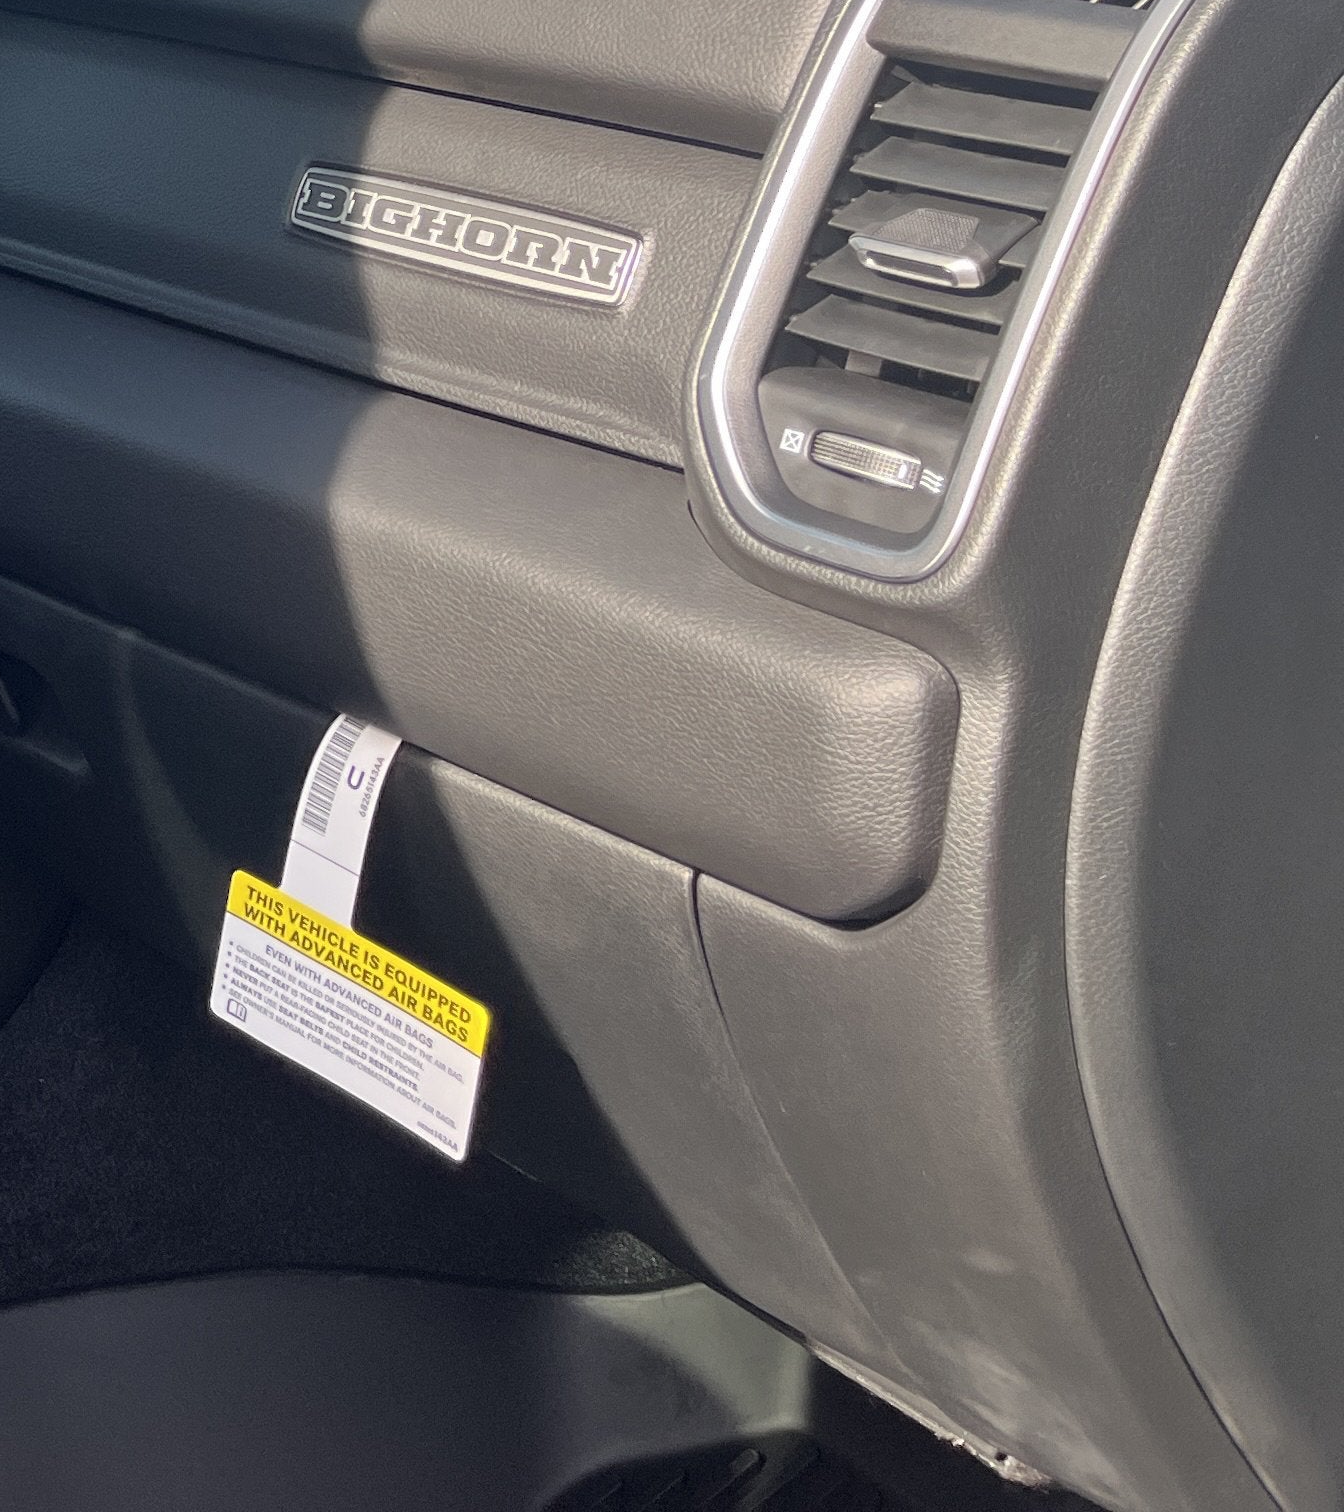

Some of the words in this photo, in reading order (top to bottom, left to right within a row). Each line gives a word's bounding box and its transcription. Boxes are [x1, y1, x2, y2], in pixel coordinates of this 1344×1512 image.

[297, 178, 628, 291] BIGHORN
[234, 954, 247, 968] THE
[249, 963, 269, 980] BACK
[271, 976, 289, 992] SEAT
[299, 992, 313, 1006] THE
[314, 1001, 344, 1023] SAFEST
[346, 1018, 369, 1037] PLACE
[370, 1032, 385, 1046] FOR
[235, 943, 270, 969] CHILDREN
[271, 963, 286, 978] CAN
[297, 979, 322, 999] KILLED
[418, 1049, 432, 1063] THE
[434, 1058, 446, 1071] AIR
[243, 902, 286, 937] WITH
[289, 929, 384, 992] ADVANCED
[388, 984, 418, 1012] AIR
[422, 1004, 468, 1043] BAGS
[246, 885, 283, 917] THIS
[287, 908, 359, 959] VEHICLE
[362, 950, 380, 971] IS
[384, 962, 471, 1025] EQUIPPED
[265, 944, 291, 967] EVEN
[293, 960, 321, 983] WITH
[323, 977, 382, 1018] ADVANCED
[384, 1012, 402, 1030] AIR
[404, 1024, 433, 1048] BAGS
[228, 987, 241, 1000] SEE
[275, 1014, 305, 1038] MANUAL
[306, 1033, 321, 1047] FOR
[323, 1042, 344, 1060] MORE
[396, 1085, 420, 1106] ABOUT
[421, 1101, 434, 1114] AIR
[230, 977, 262, 1000] ALWAYS
[278, 1004, 298, 1021] SEAT
[299, 1016, 323, 1036] BELTS
[324, 1031, 341, 1046] AND
[341, 1040, 367, 1060] CHILD
[232, 965, 258, 986] NEVER
[259, 981, 273, 994] PUT
[327, 1020, 349, 1038] CHILD
[351, 1033, 368, 1049] SEAT
[379, 1050, 394, 1064] THE
